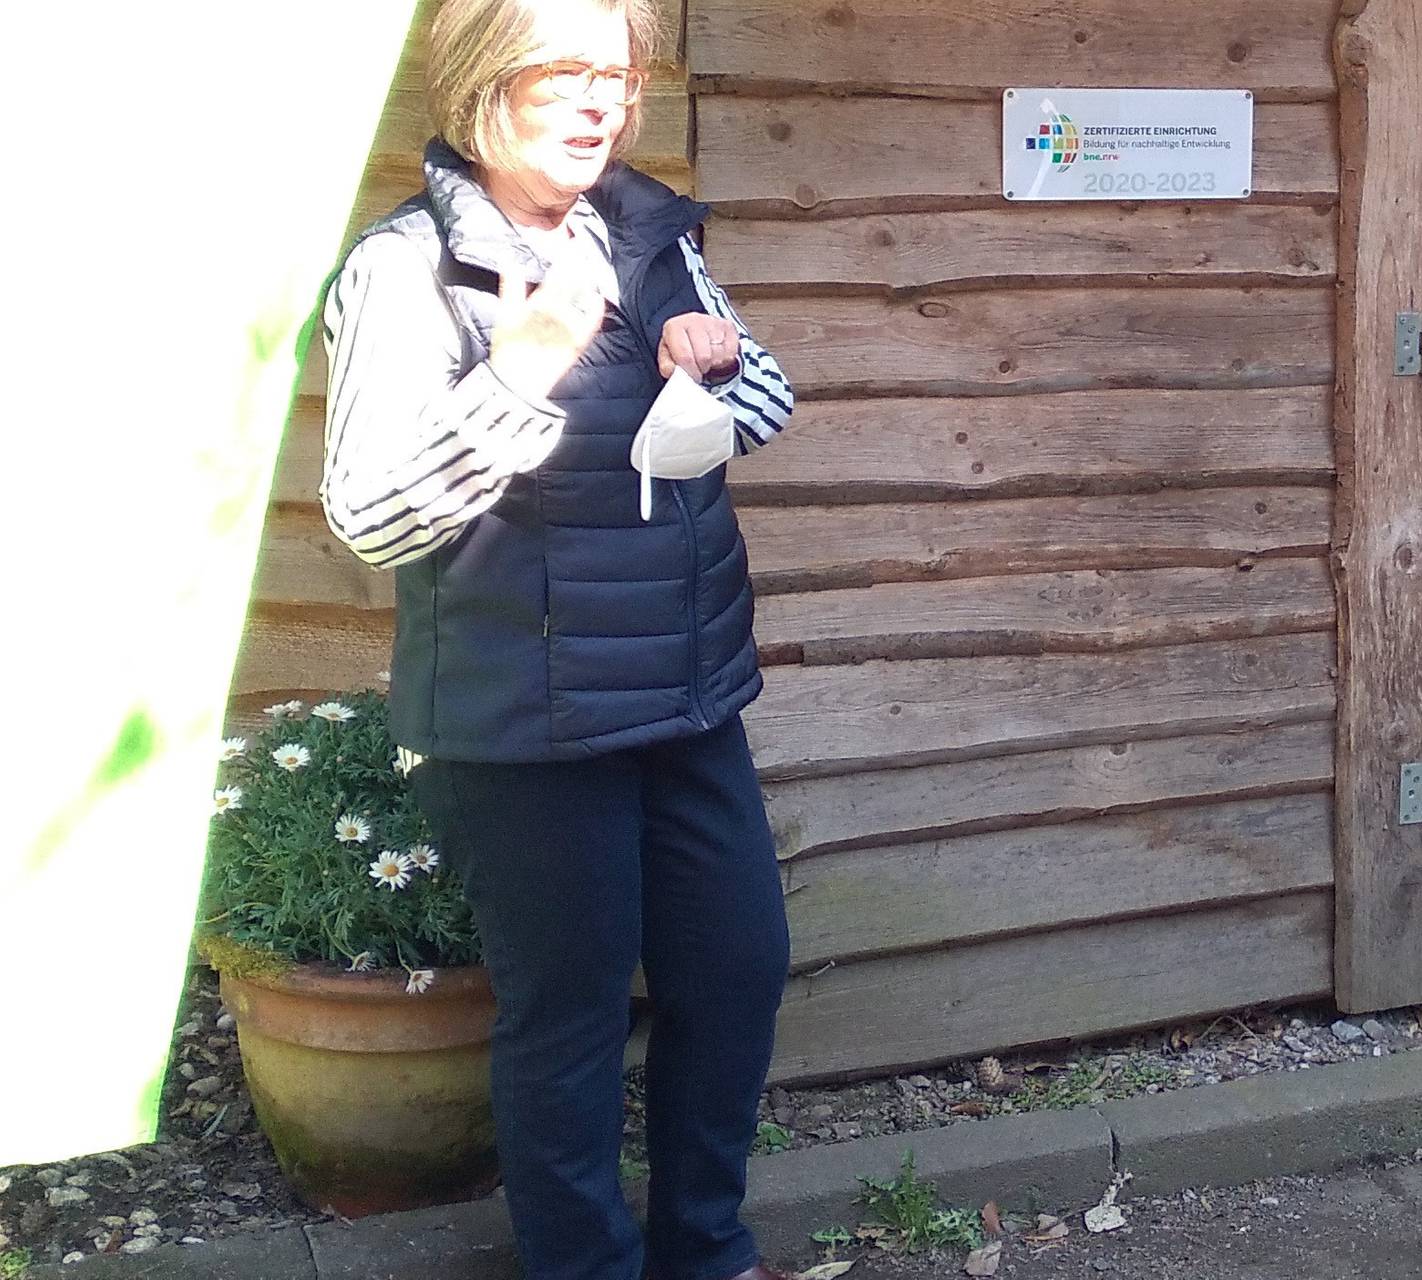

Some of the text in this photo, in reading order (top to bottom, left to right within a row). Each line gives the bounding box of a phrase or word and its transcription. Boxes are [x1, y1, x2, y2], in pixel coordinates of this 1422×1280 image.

[1083, 126, 1217, 136] ZERTIFIZIERTE EINRICHTUNG
[1083, 139, 1231, 150] Bildung für nachhaltige Entwicklung
[1083, 172, 1217, 193] 2020-2023
